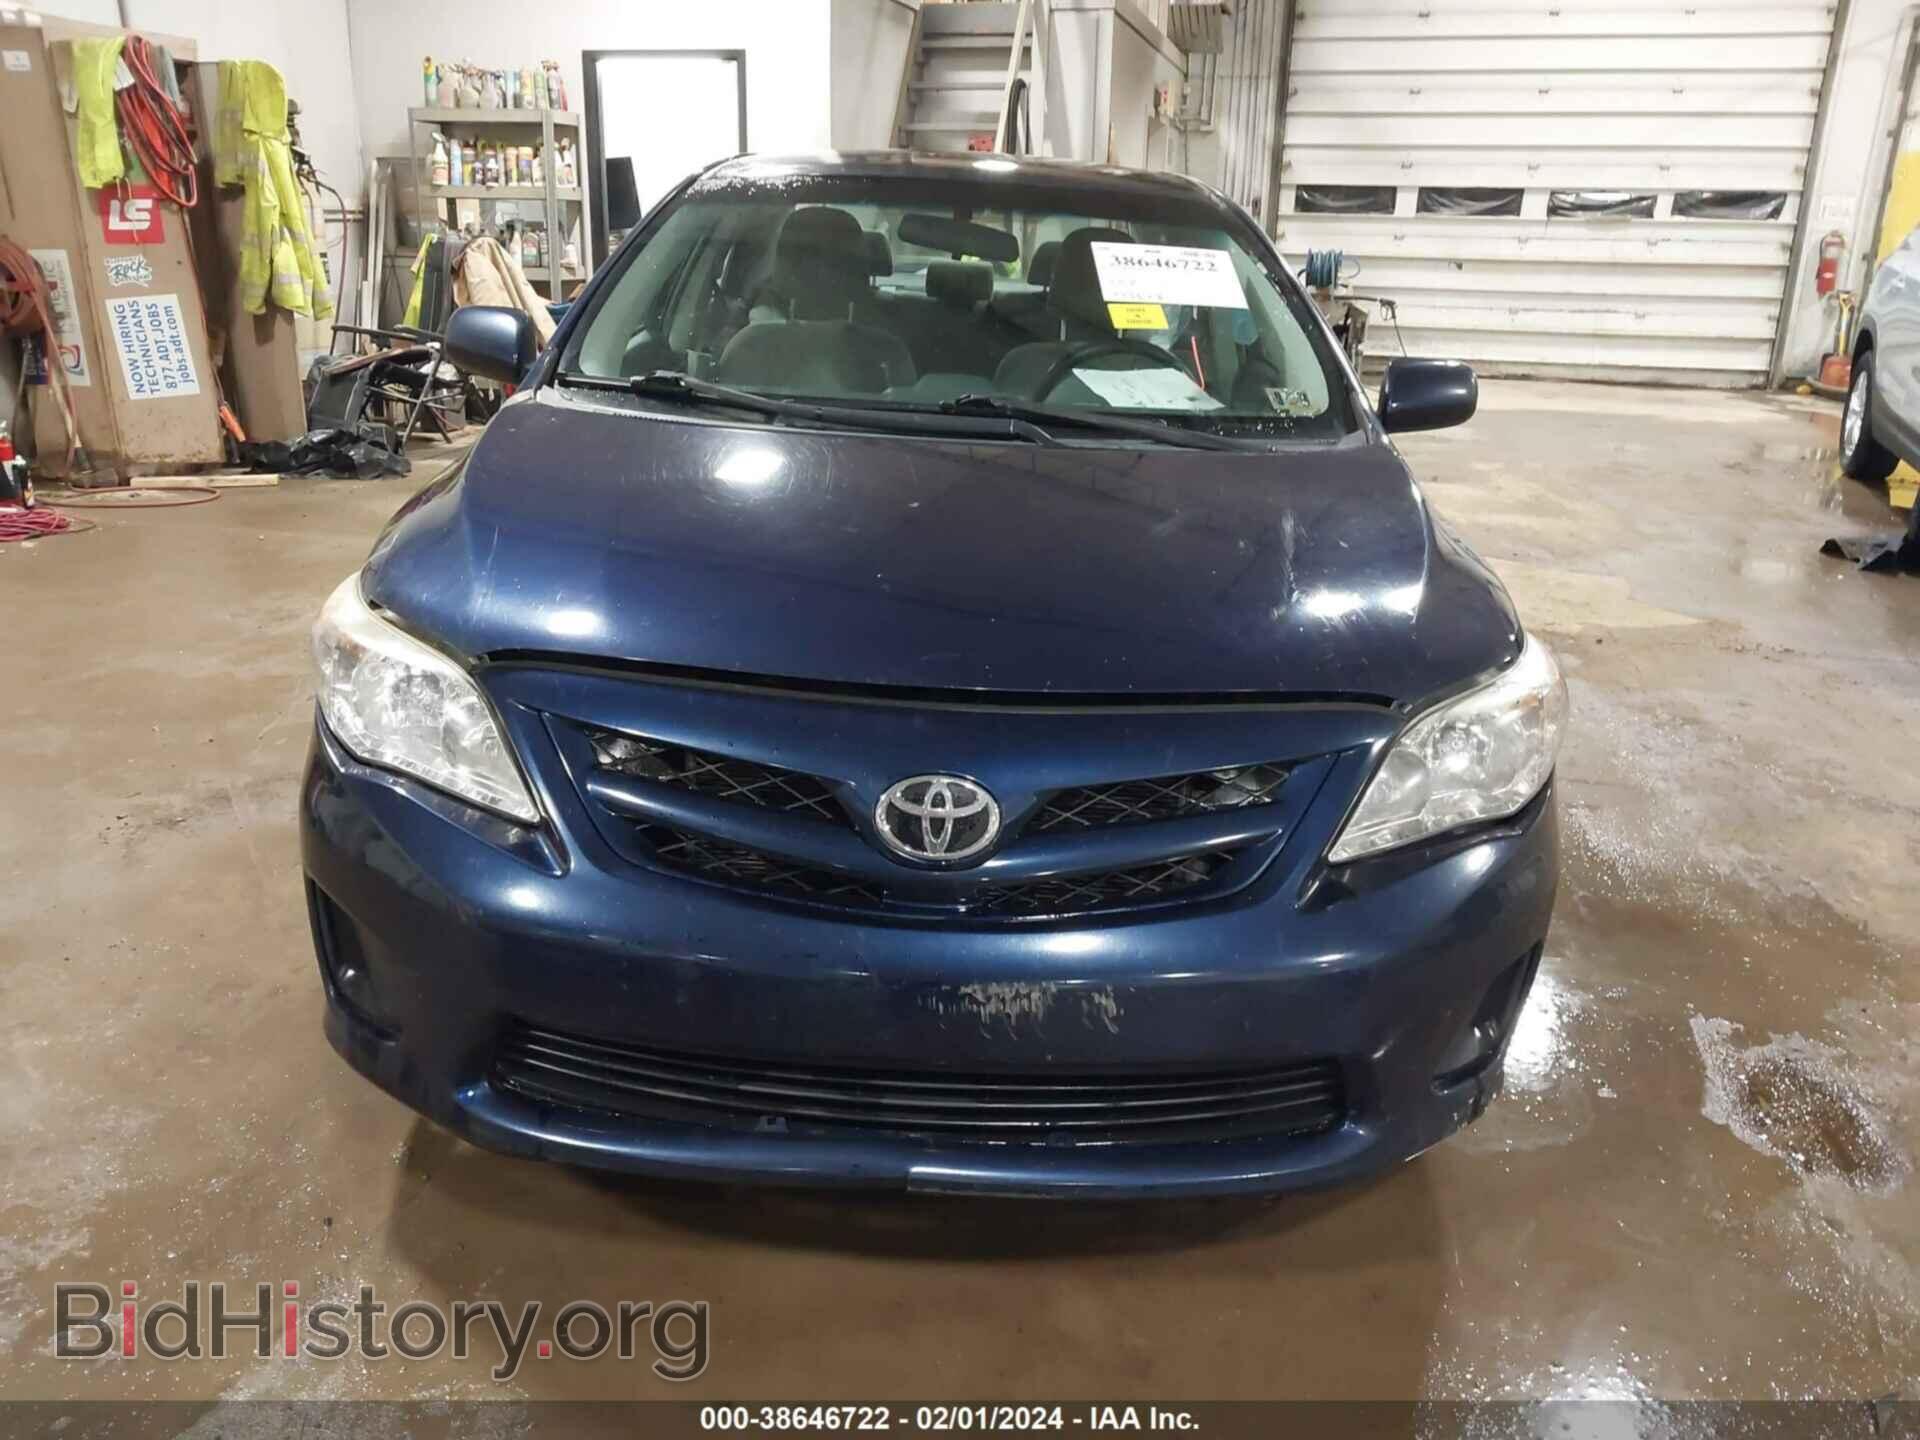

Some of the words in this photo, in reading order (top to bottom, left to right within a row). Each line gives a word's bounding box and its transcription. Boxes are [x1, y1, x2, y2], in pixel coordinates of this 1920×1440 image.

[1111, 255, 1218, 271] 38646722
[114, 304, 134, 351] HIRING
[128, 300, 160, 394] TECHNICIANS
[148, 303, 177, 389] 877.ADT.JOBS
[163, 305, 195, 384] jobs.adt.com
[129, 356, 146, 394] NOW
